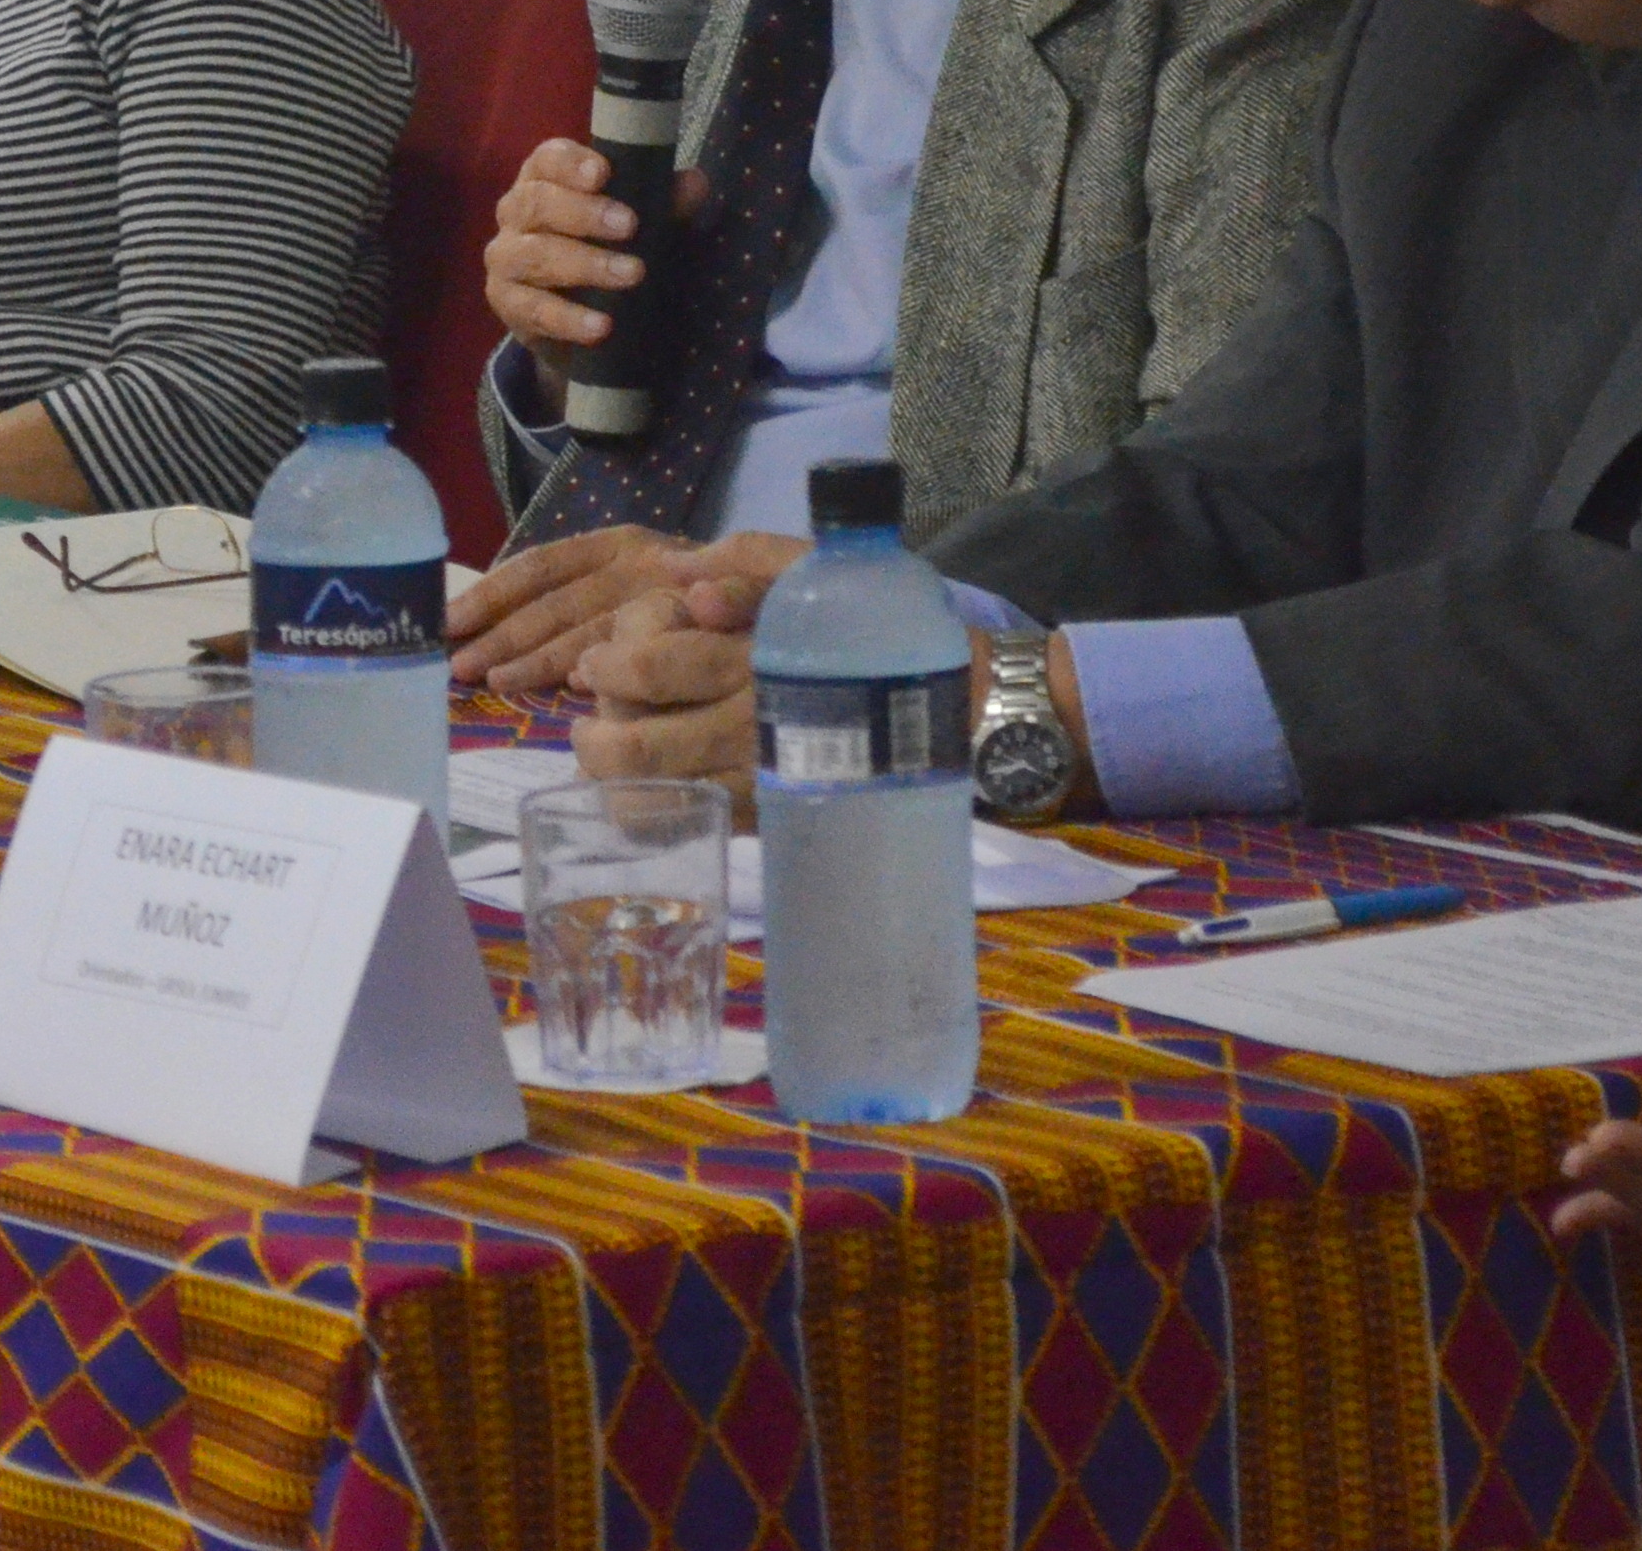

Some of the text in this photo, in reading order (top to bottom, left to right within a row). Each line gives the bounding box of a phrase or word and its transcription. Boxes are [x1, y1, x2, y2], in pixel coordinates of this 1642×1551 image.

[115, 827, 296, 889] ENARA ECHART
[134, 900, 232, 948] MUÑOZ
